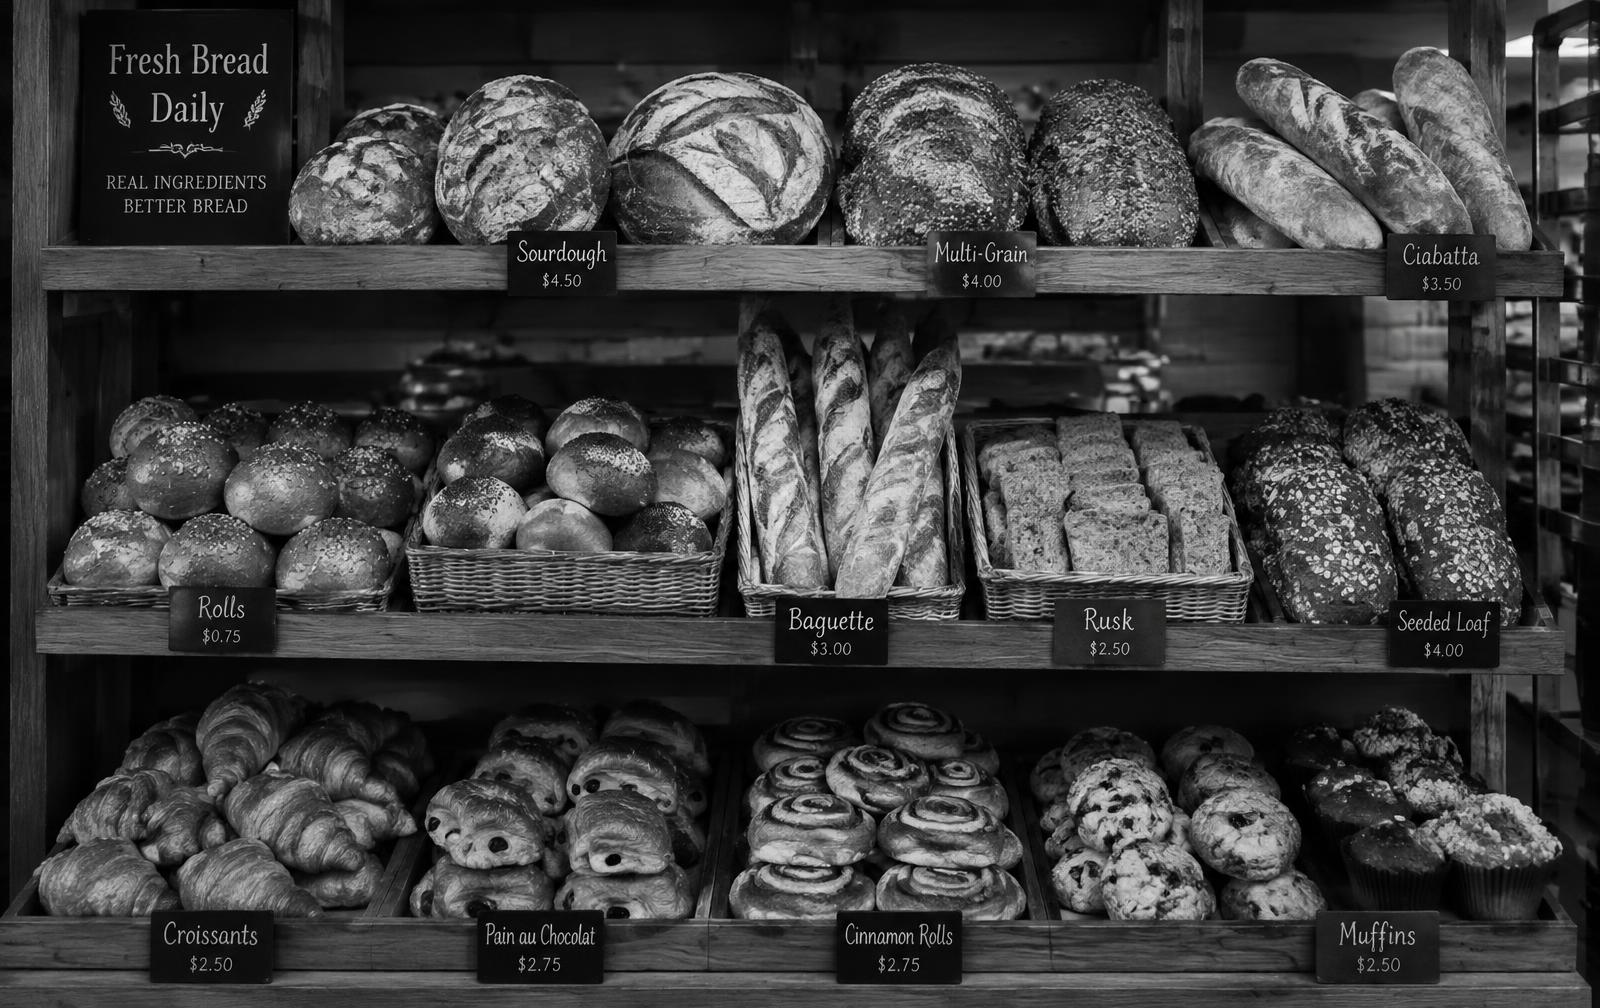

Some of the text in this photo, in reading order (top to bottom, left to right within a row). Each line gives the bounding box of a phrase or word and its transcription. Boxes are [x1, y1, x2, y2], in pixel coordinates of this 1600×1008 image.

[109, 42, 269, 75] Fresh Bread
[150, 90, 225, 134] Daily
[106, 174, 267, 190] REAL INGREDIENTS
[124, 198, 248, 214] BETTER BREAD
[516, 239, 607, 270] Sourdough
[934, 240, 1028, 264] Multi-Grain
[1403, 242, 1481, 266] Ciabatta
[542, 272, 582, 289] $4.50
[962, 273, 1002, 289] $4.00
[1422, 275, 1462, 292] $3.50
[198, 594, 245, 620] Rolls
[789, 607, 874, 639] Baguette
[1083, 607, 1135, 633] Rusk
[1397, 609, 1492, 639] Seeded Loaf
[202, 627, 241, 646] $0.75
[810, 640, 852, 656] $3.00
[1090, 640, 1130, 657] $2.50
[1424, 642, 1464, 659] $4.00
[163, 920, 258, 946] Croissants
[485, 922, 595, 946] Pain au Chocolat
[845, 922, 953, 949] Cinnamon Rolls
[1339, 920, 1416, 953] Muffins
[190, 955, 233, 973] $2.50
[518, 955, 561, 974] $2.75
[878, 954, 920, 974] $2.75
[1357, 955, 1401, 974] $2.50
